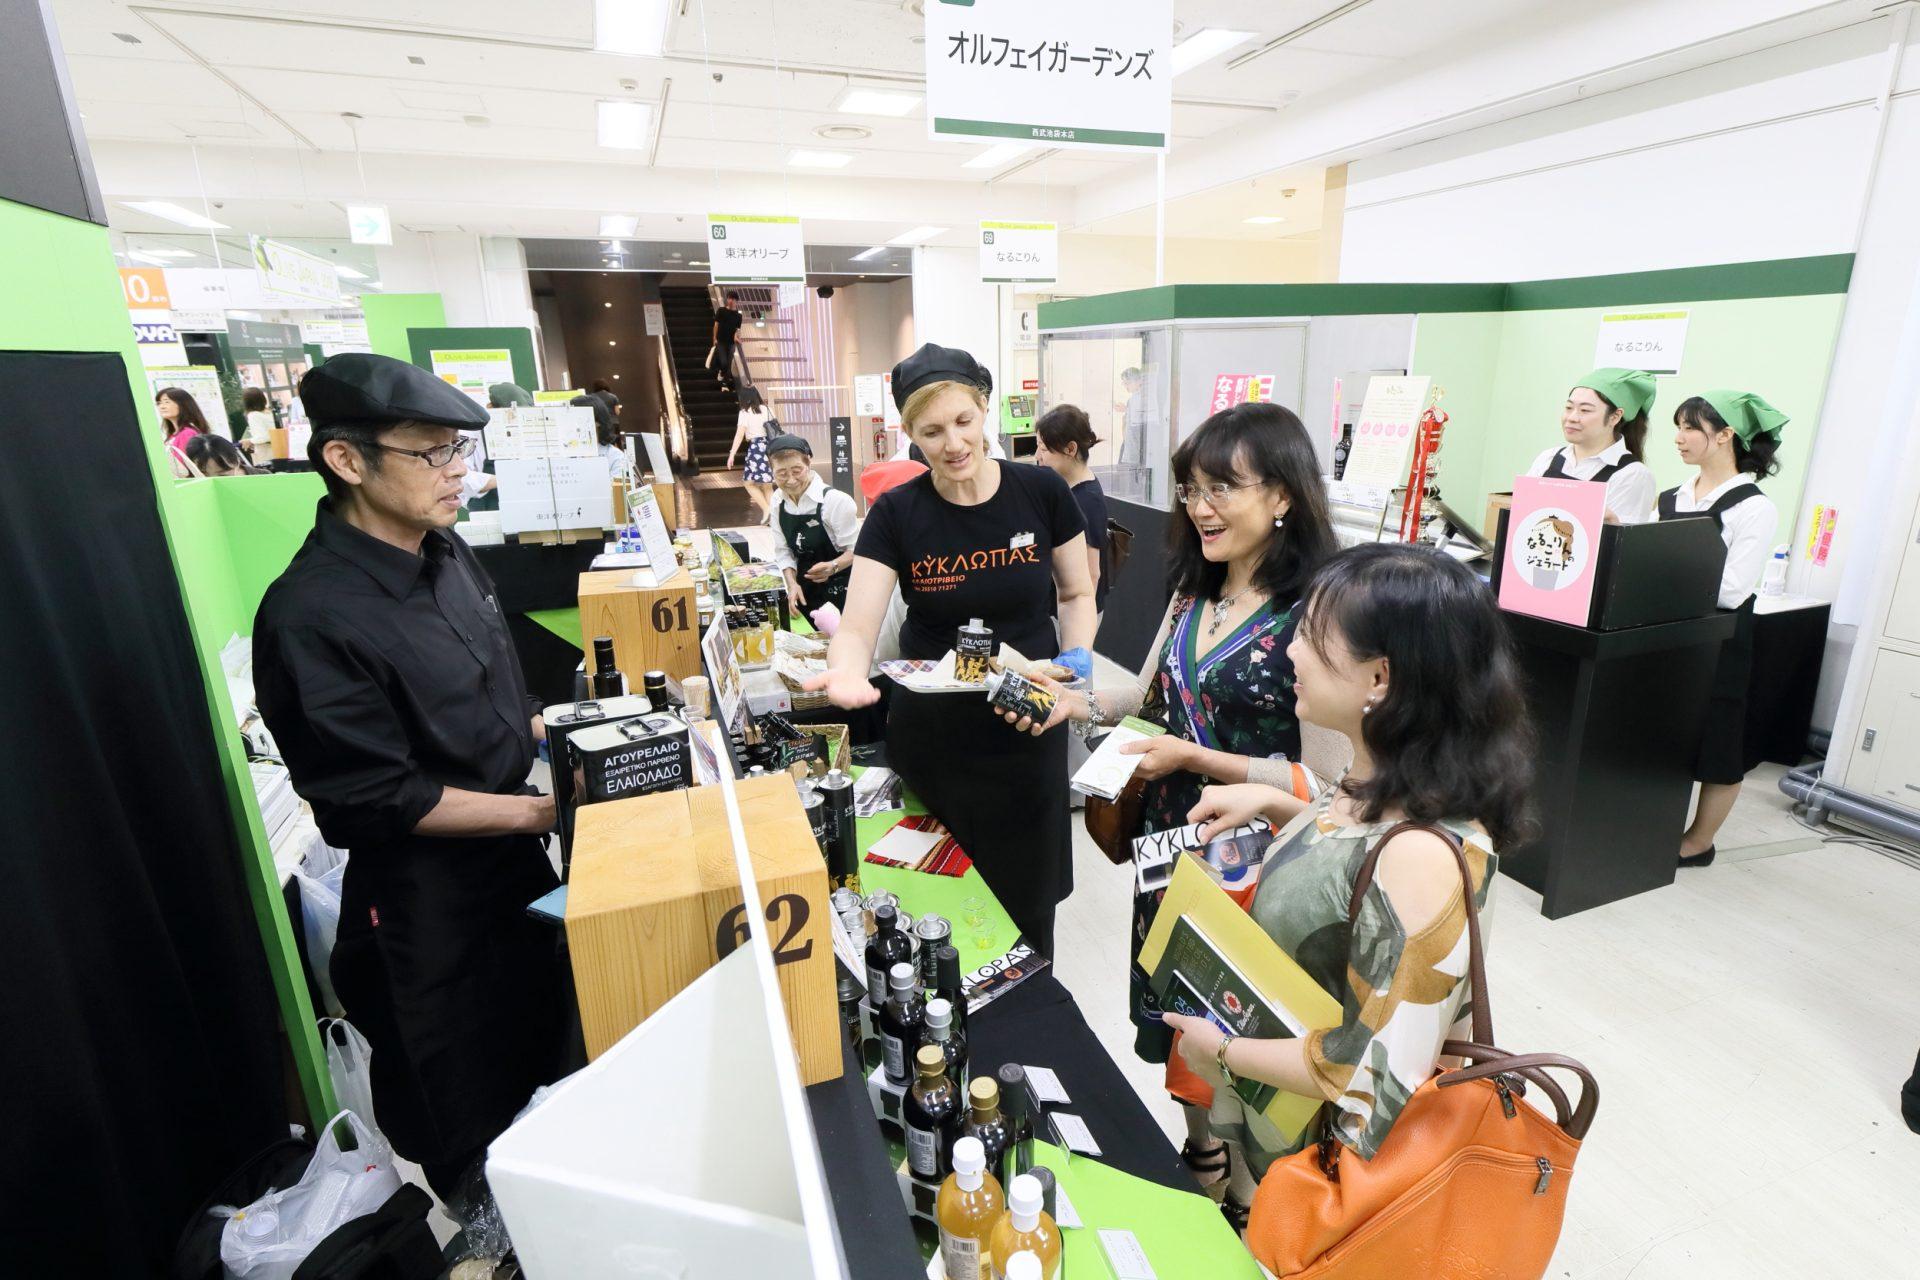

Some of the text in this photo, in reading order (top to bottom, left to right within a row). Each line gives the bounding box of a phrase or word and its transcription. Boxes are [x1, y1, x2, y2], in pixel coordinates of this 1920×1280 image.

[948, 30, 1155, 80] オルフェイガーデンズ
[1032, 127, 1075, 139] 西武池袋本店
[713, 226, 725, 238] 60
[725, 247, 789, 259] 東洋オリーブ
[997, 251, 1040, 263] なるこりん
[1614, 341, 1663, 352] なるこりん
[1527, 555, 1569, 571] ジェラート
[651, 595, 691, 634] 61
[604, 741, 680, 768] ΑΓΟΥΡΕΛΑΙΟ
[605, 753, 680, 778] ΕΞΑΙΡΕΤΙΚΟ ΠΑΡΘΕΝΟ
[606, 763, 681, 794] ΕΛΑΙΟΛΑΔΟ
